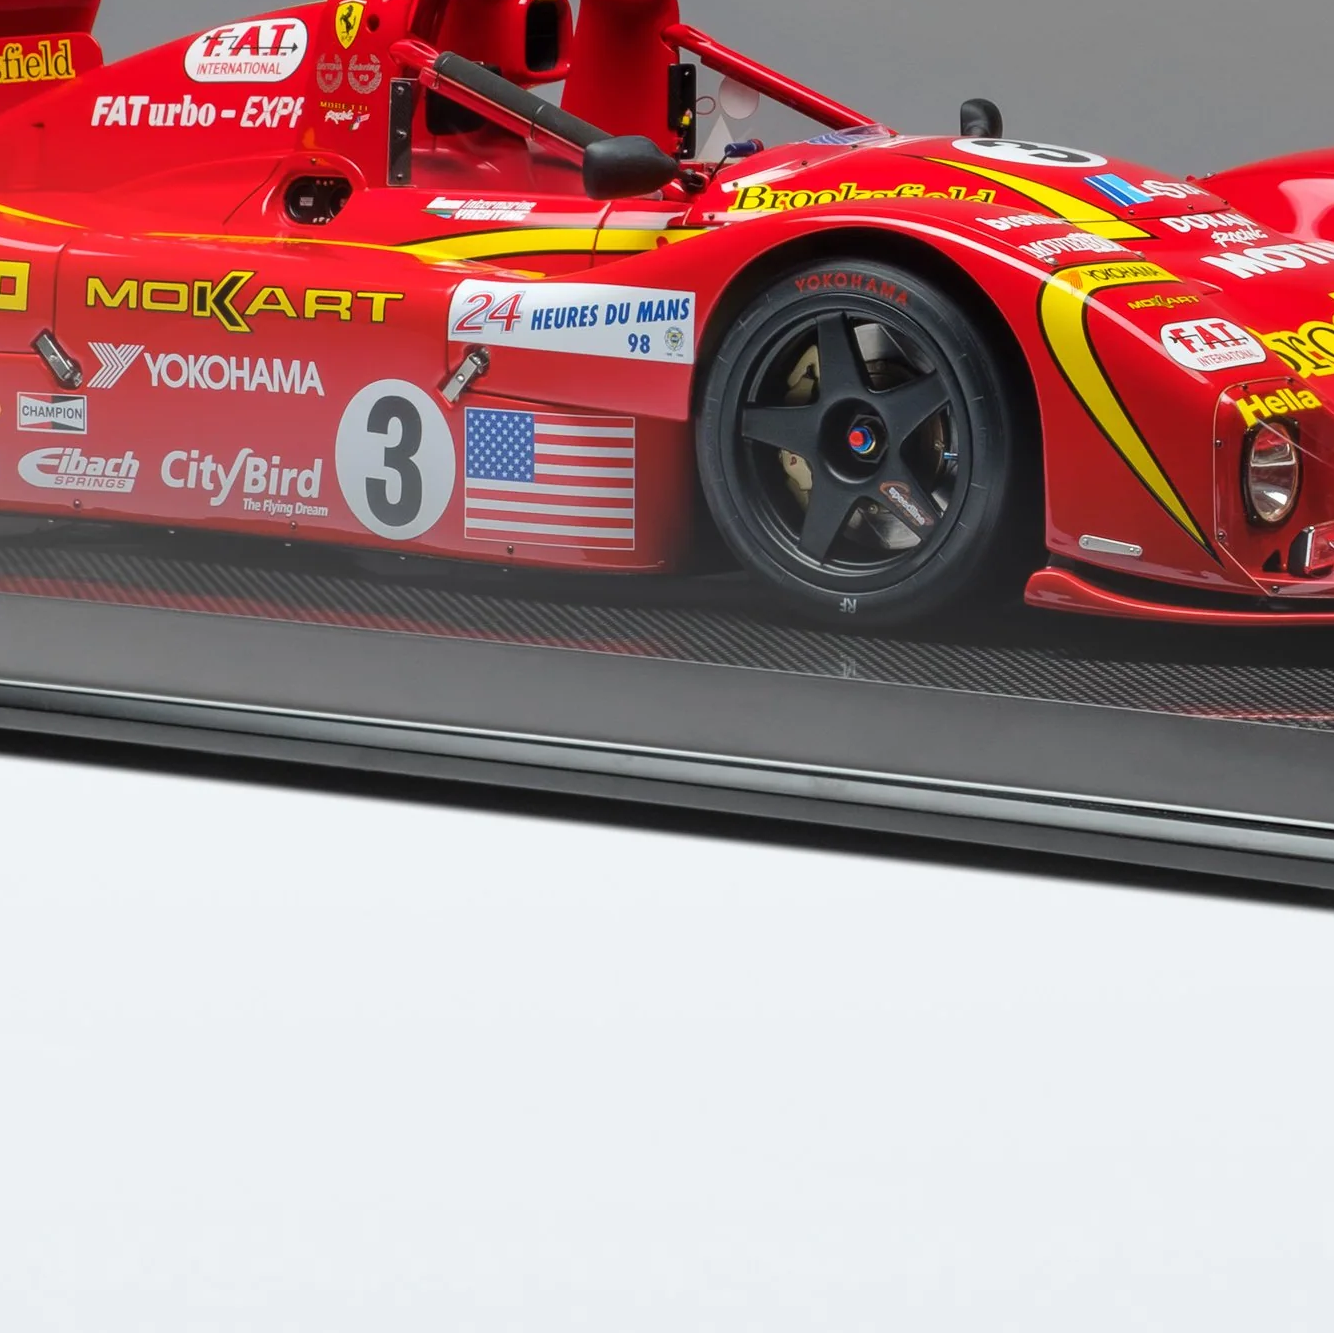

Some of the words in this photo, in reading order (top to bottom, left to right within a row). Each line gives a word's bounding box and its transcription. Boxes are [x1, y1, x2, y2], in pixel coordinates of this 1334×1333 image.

[202, 23, 296, 57] F.A.T.
[196, 62, 282, 75] INTERNATIONAL
[970, 139, 1092, 163] 3
[1160, 212, 1258, 233] DORAN
[1083, 266, 1160, 282] YOKOHAMA
[794, 272, 909, 306] YOKOHAMA
[452, 291, 527, 334] 24
[530, 302, 599, 331] HEURES
[604, 300, 633, 325] DU
[635, 296, 691, 323] MANS
[627, 333, 652, 355] 98
[1196, 348, 1261, 367] INTERNATIONAL
[144, 351, 326, 397] YOKOHAMA
[21, 404, 83, 420] CHAMPION
[1235, 387, 1323, 428] Hella
[18, 447, 140, 481] Eibach
[364, 394, 423, 527] 3
[54, 476, 127, 489] SPRINGS
[160, 447, 323, 507] CityBird
[242, 497, 260, 511] The
[263, 500, 293, 516] Flying
[295, 502, 328, 516] Dream
